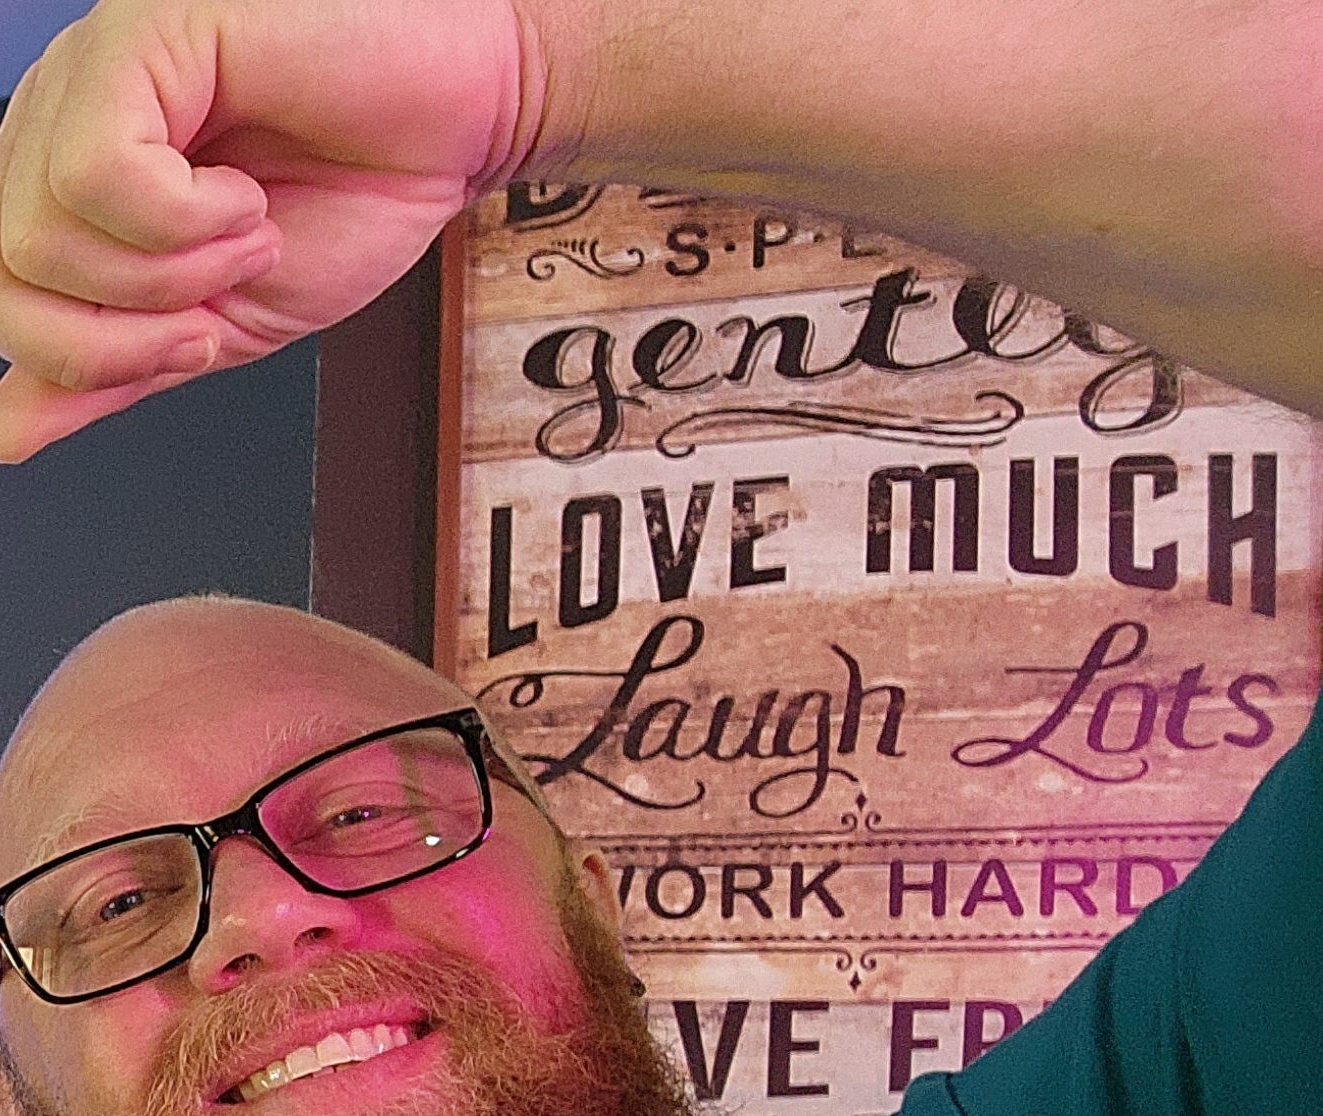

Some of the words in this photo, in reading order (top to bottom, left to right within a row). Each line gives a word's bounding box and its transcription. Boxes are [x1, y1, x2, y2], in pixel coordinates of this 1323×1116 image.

[488, 473, 791, 658] LOVE
[866, 452, 1277, 615] MUCH
[476, 616, 906, 817] Laugh
[951, 620, 1278, 783] Lots
[618, 860, 844, 920] ORK
[889, 856, 1178, 919] HARD
